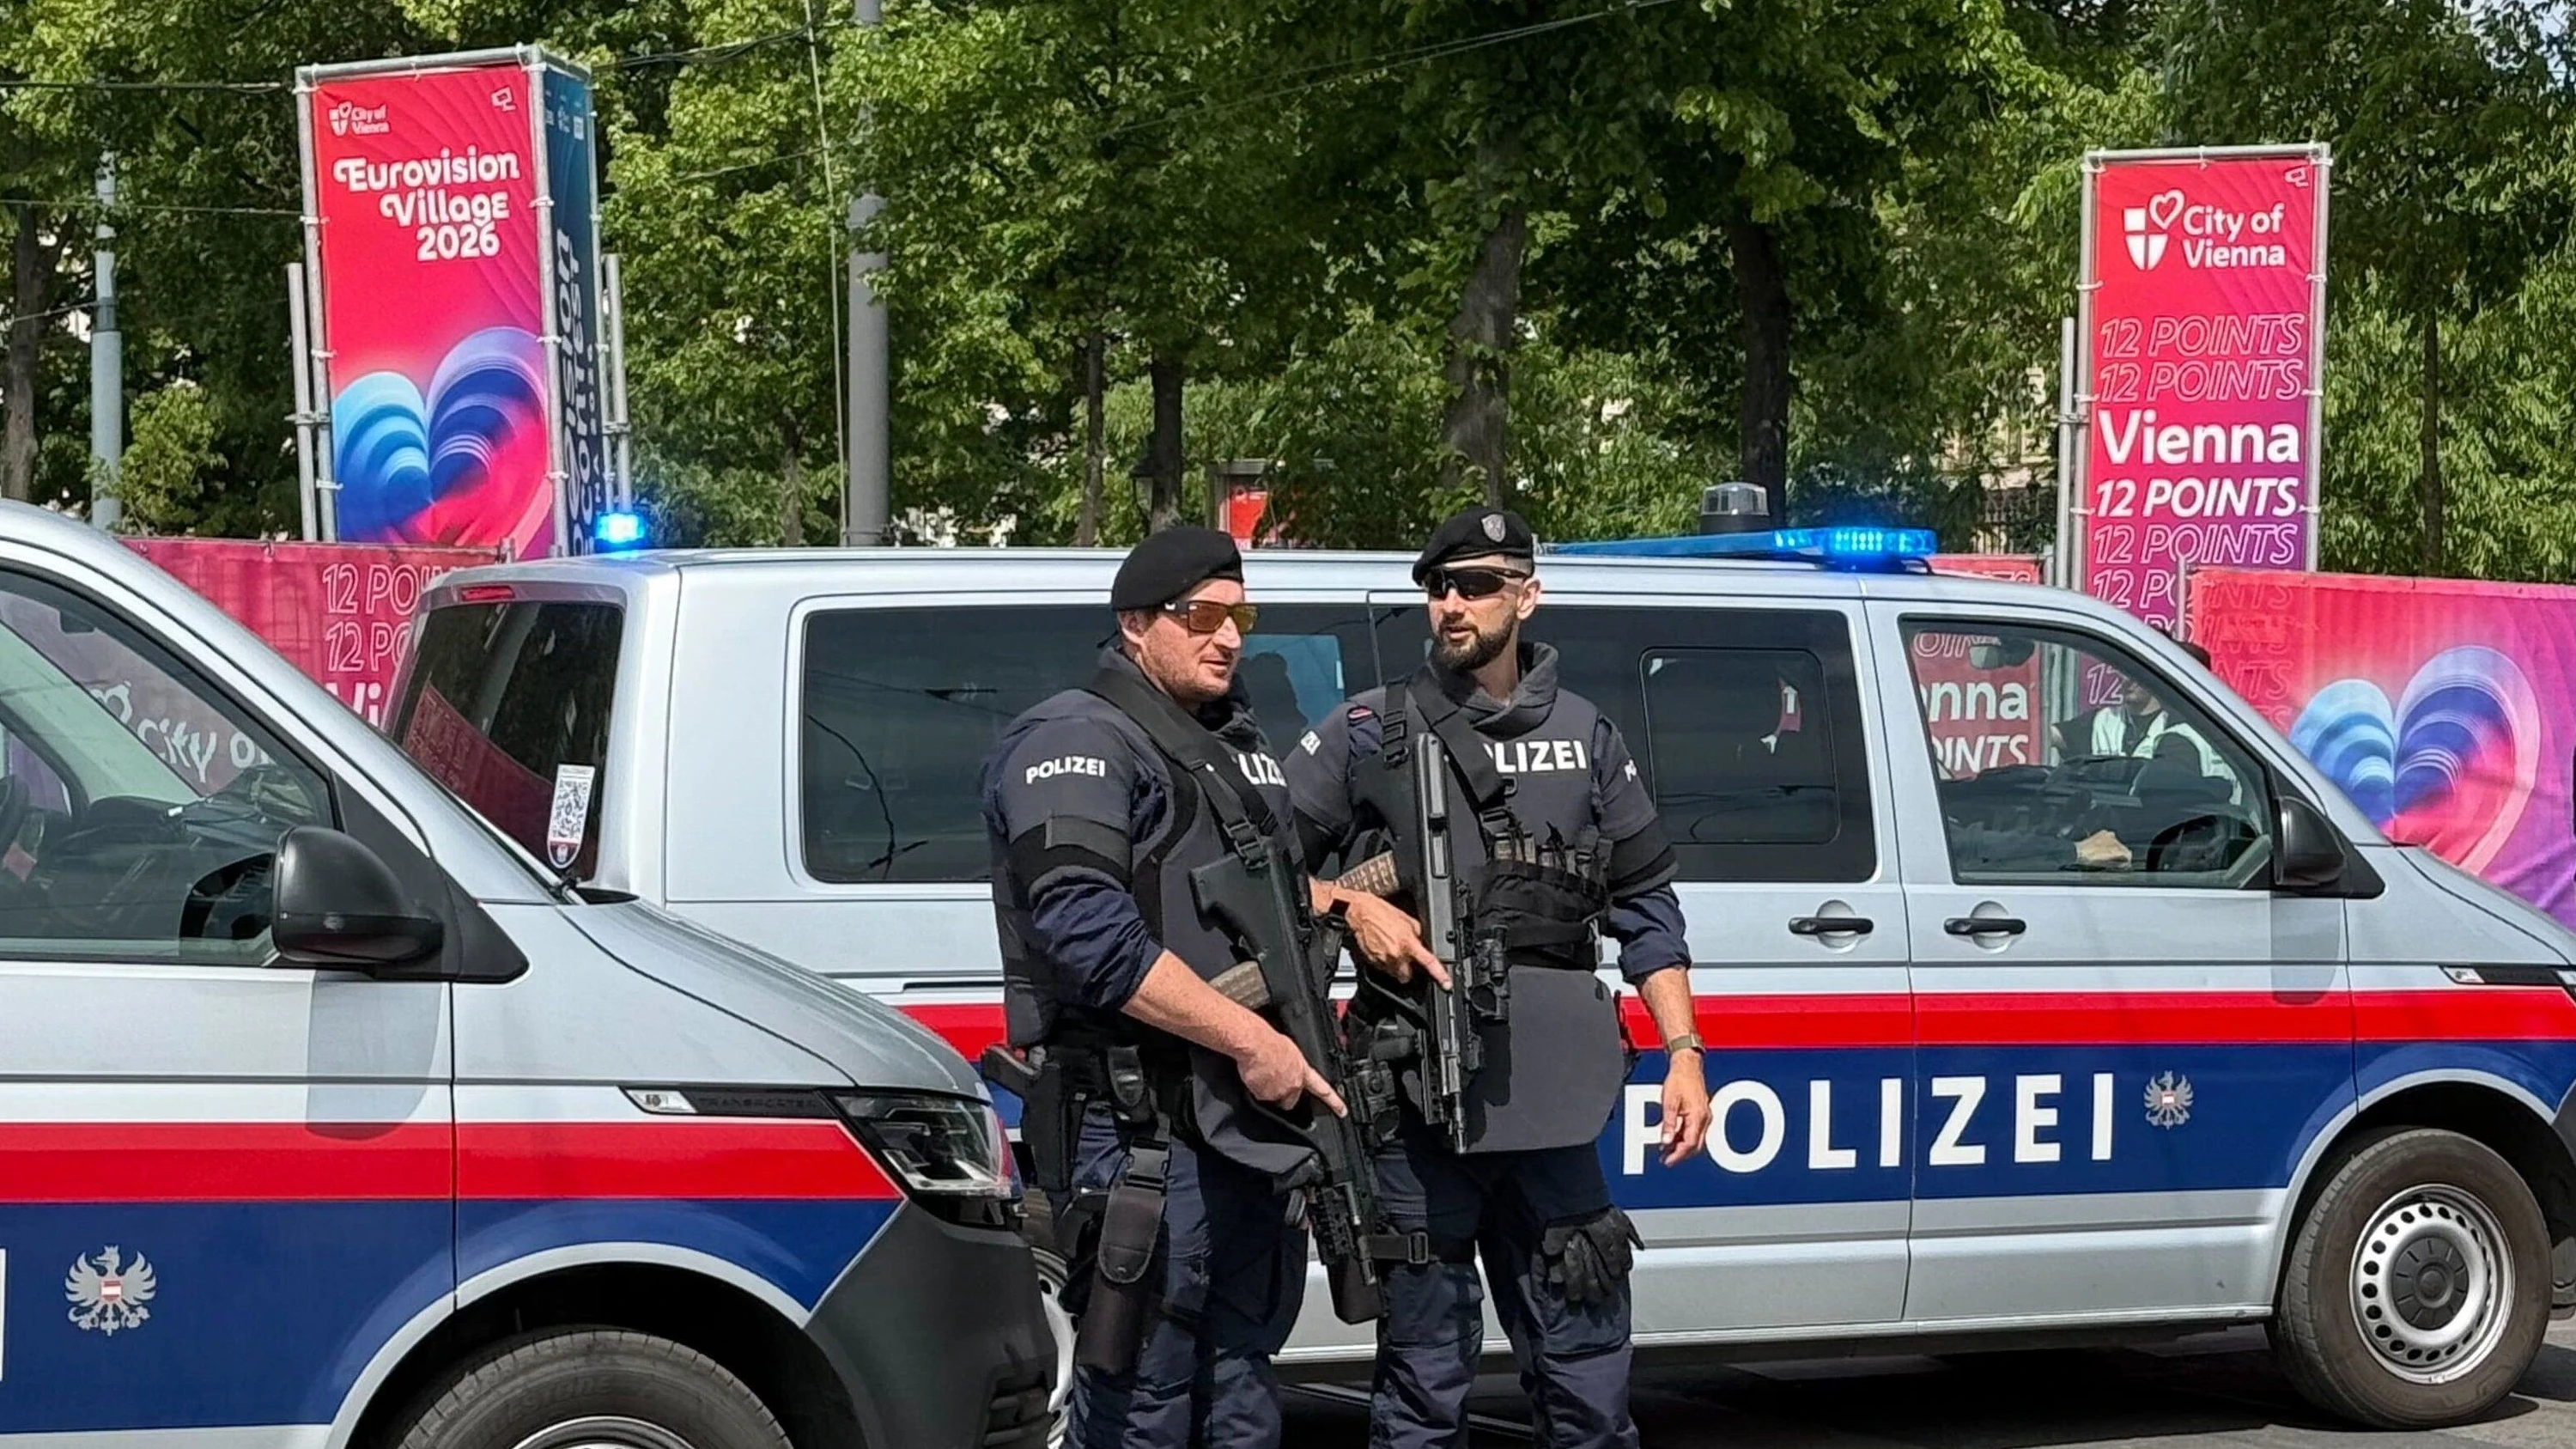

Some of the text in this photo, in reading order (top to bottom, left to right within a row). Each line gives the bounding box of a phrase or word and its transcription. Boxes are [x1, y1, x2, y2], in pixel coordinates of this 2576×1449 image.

[333, 144, 520, 192] Eurovision
[380, 187, 510, 227] Village
[2183, 203, 2286, 243] City of
[416, 220, 501, 261] 2026
[2181, 237, 2286, 269] Vienna
[2100, 313, 2305, 357] 12 POINTS
[2099, 358, 2304, 403] 12 POINTS
[2097, 408, 2300, 465] Vienna
[2096, 477, 2299, 517] 12 POINTS
[2093, 522, 2299, 564] 12 POINTS
[322, 563, 359, 614] 12
[2093, 569, 2135, 609] 12
[325, 621, 365, 672] 12
[1920, 682, 2029, 722] nna
[2087, 662, 2124, 705] 12
[1025, 756, 1106, 784] POLIZEI
[1483, 740, 1588, 774] LIZEI
[1622, 1073, 2114, 1175] POLIZEI
